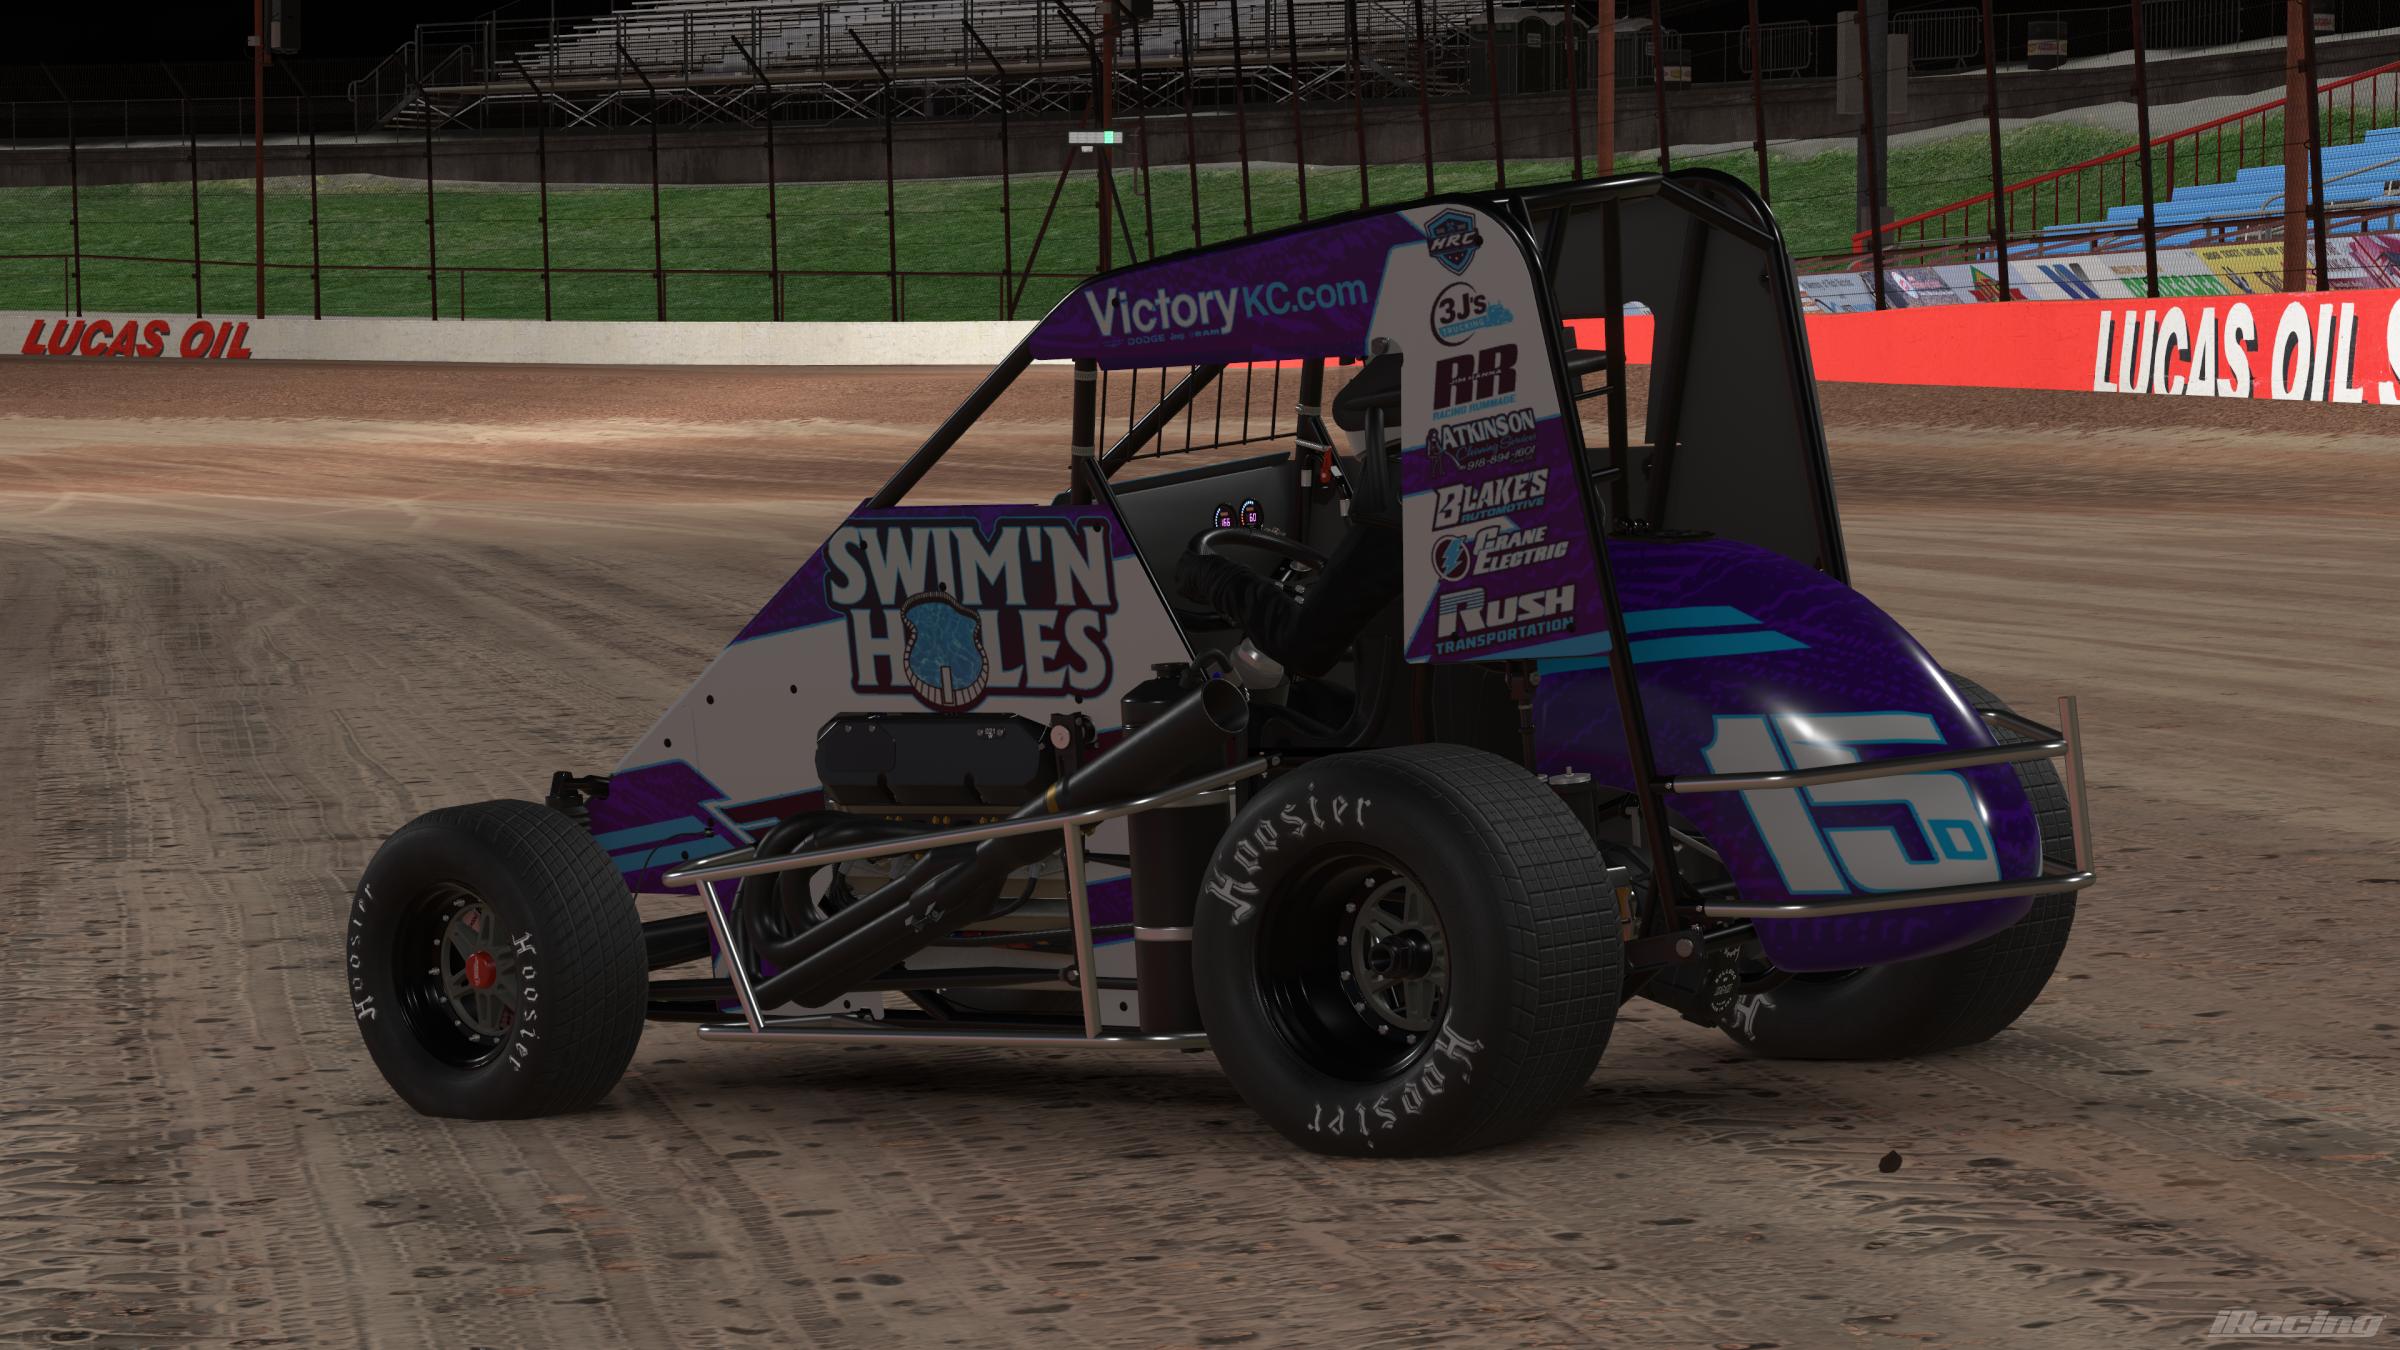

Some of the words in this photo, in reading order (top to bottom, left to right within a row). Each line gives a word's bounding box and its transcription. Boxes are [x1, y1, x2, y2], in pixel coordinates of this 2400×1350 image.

[1084, 279, 1368, 337] VictoryKC.com
[1439, 293, 1488, 324] 3J's
[21, 319, 171, 358] LUCAS
[179, 320, 253, 359] OIL
[1127, 334, 1165, 346] DODGE
[2093, 302, 2259, 400] LUCAS
[2271, 301, 2364, 403] OIL
[1433, 343, 1518, 410] RR
[1441, 408, 1537, 450] ATKINSON
[1461, 497, 1544, 523] AUTOMOTIVE
[1472, 541, 1569, 576] ELECTRIC
[1473, 525, 1548, 555] CRANE
[828, 525, 1113, 606] SWIM'N
[1438, 584, 1576, 638] RUSH
[1435, 616, 1575, 655] TRANSPORTATION
[1205, 781, 1371, 926] Hoosier
